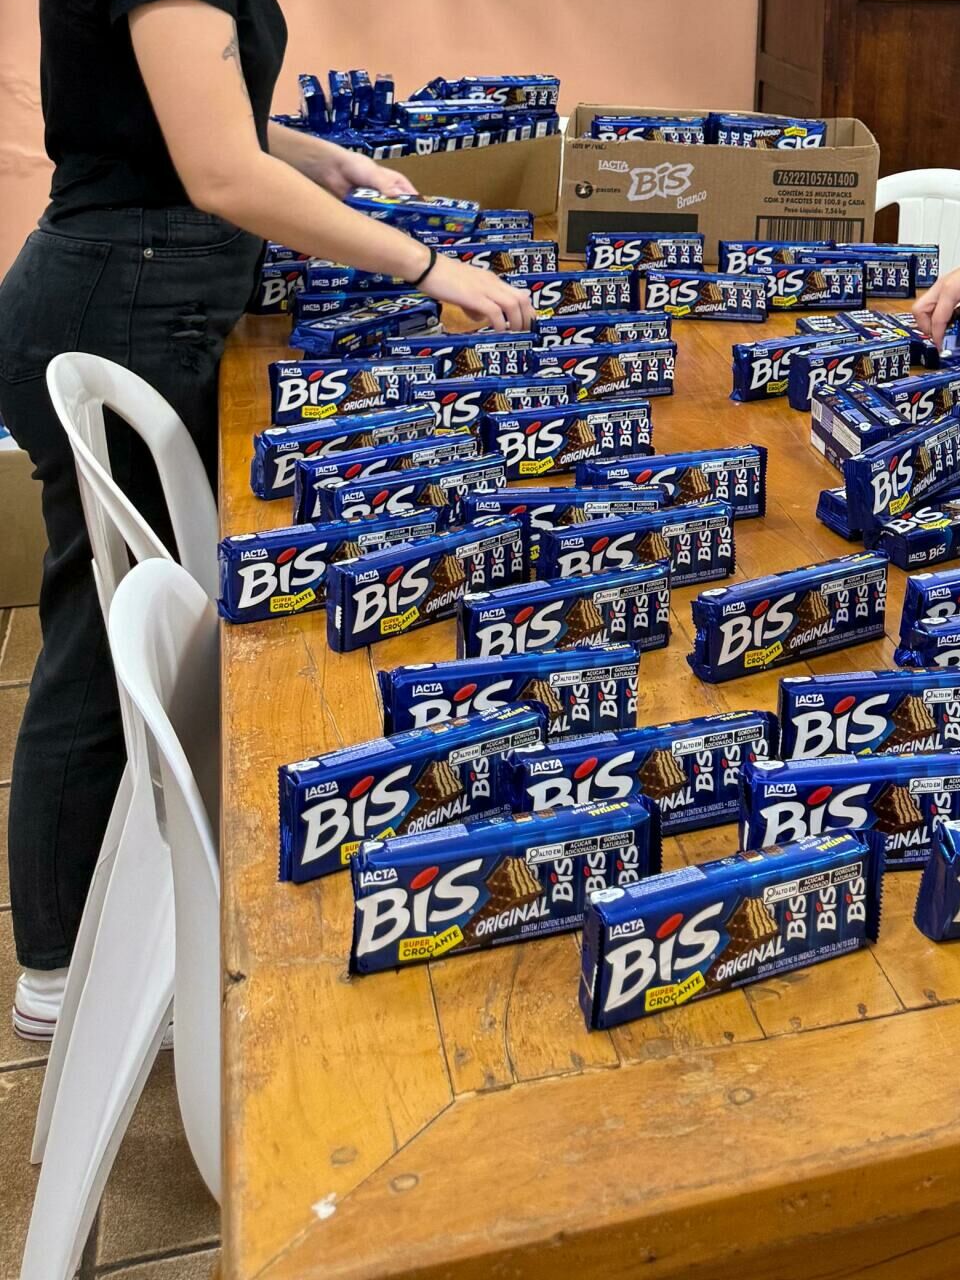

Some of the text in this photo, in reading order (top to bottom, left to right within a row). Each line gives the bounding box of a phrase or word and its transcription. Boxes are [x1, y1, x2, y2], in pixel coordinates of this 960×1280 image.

[599, 160, 629, 172] LACTA
[677, 191, 707, 208] Branco
[593, 240, 643, 269] BiS
[726, 246, 773, 274] BiS
[638, 259, 668, 270] ORIGINAL
[331, 276, 349, 288] BiS
[647, 279, 701, 308] BiS
[801, 290, 831, 302] ORIGINAL
[322, 300, 340, 312] BiS
[559, 300, 592, 313] ORIGINAL
[695, 301, 727, 312] ORIGINAL
[391, 346, 411, 354] LACTA
[540, 357, 558, 365] LACTA
[750, 347, 801, 390] BiS
[281, 367, 302, 376] LACTA
[808, 356, 855, 398] BiS
[278, 369, 348, 412] BiS
[415, 390, 436, 400] LACTA
[593, 379, 631, 395] ORIGINAL
[304, 404, 335, 417] CROCANTE
[344, 396, 386, 412] ORIGINAL
[896, 387, 935, 422] BiS
[499, 420, 520, 430] LACTA
[277, 441, 299, 452] LACTA
[496, 419, 564, 467] BiS
[560, 444, 601, 464] ORIGINAL
[316, 464, 338, 476] LACTA
[521, 459, 553, 472] CROCANTE
[608, 469, 629, 480] LACTA
[871, 449, 913, 515] BiS
[912, 475, 937, 497] ORIGINAL
[342, 491, 365, 504] LACTA
[476, 502, 500, 512] LACTA
[888, 507, 944, 534] BiS
[561, 537, 584, 549] LACTA
[241, 548, 268, 561] LACTA
[558, 532, 637, 578] BiS
[909, 551, 927, 562] LACTA
[909, 552, 927, 562] LACTA
[929, 544, 946, 559] BiS
[929, 545, 946, 561] BiS
[237, 542, 328, 609] BiS
[355, 570, 379, 585] LACTA
[272, 596, 292, 604] SUPER
[272, 592, 312, 611] CROCANTE
[352, 558, 431, 634] BiS
[426, 581, 471, 613] ORIGINAL
[928, 588, 951, 600] LACTA
[480, 607, 506, 621] LACTA
[723, 601, 746, 616] LACTA
[382, 618, 400, 626] SUPER
[383, 610, 417, 631] CROCANTE
[476, 600, 564, 658] BiS
[717, 592, 797, 666] BiS
[790, 618, 836, 649] ORIGINAL
[747, 645, 781, 665] CROCANTE
[412, 682, 443, 697] LACTA
[408, 679, 513, 730] BiS
[796, 694, 824, 707] LACTA
[792, 694, 890, 759] BiS
[885, 734, 944, 754] ORIGINAL
[530, 759, 563, 775] LACTA
[695, 752, 715, 792] BiS
[471, 758, 490, 798] BiS
[527, 750, 636, 811] BiS
[305, 781, 339, 802] LACTA
[764, 784, 797, 798] LACTA
[300, 765, 412, 865] BiS
[407, 793, 471, 835] ORIGINAL
[760, 783, 871, 847] BiS
[603, 840, 629, 848] SATURADA
[604, 834, 629, 842] GORDURA
[565, 845, 597, 856] ADICIONADO
[360, 868, 398, 887] LACTA
[834, 872, 858, 882] SATURADA
[835, 865, 857, 876] GORDURA
[552, 858, 574, 903] BiS
[800, 880, 829, 892] ADICIONADO
[356, 859, 483, 958] BiS
[847, 877, 867, 924] BiS
[475, 896, 550, 937] ORIGINAL
[816, 887, 837, 932] BiS
[787, 894, 807, 942] BiS
[609, 918, 646, 940] LACTA
[403, 939, 430, 948] SUPER
[403, 930, 460, 957] CROCANTE
[604, 902, 724, 1012] BiS
[715, 938, 785, 981] ORIGINAL
[649, 976, 702, 1008] CROCANTE
[650, 987, 674, 998] SUPER
